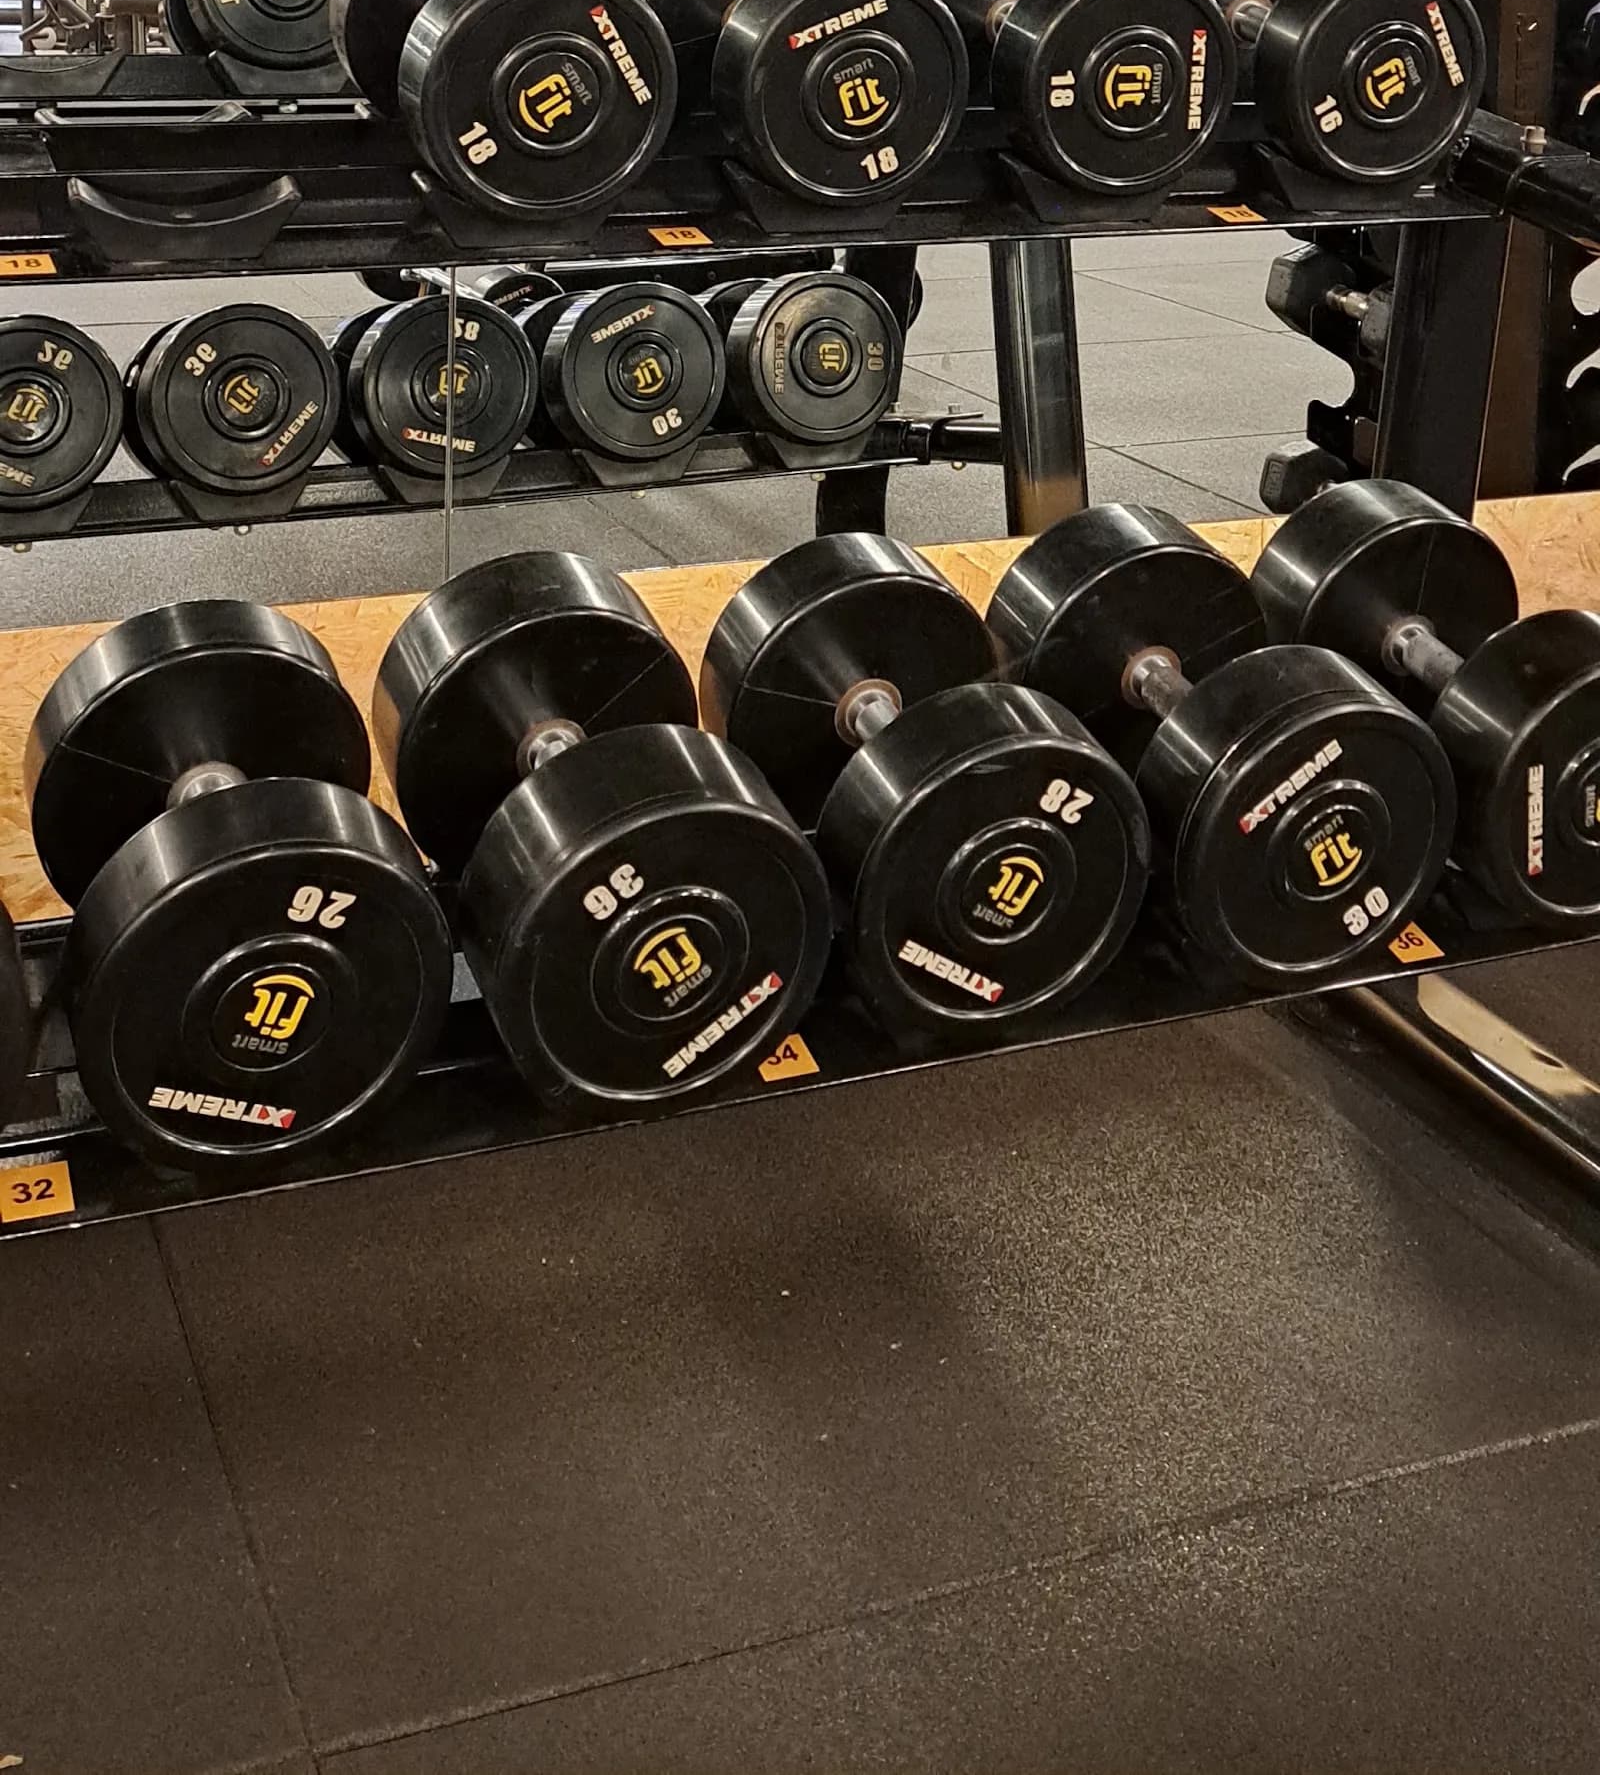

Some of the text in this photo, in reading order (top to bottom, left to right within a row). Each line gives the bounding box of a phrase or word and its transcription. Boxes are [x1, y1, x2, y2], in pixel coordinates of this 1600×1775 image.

[589, 4, 652, 106] XTREME
[1425, 1, 1465, 87] XTREME
[562, 62, 592, 106] smart
[833, 57, 874, 85] smart
[1050, 69, 1076, 108] 18
[1116, 63, 1153, 109] fit
[1151, 62, 1163, 105] smart
[1187, 28, 1208, 130] XTREME
[1372, 57, 1407, 106] fit
[1404, 53, 1421, 87] mart
[525, 73, 573, 129] fit
[838, 76, 886, 119] fit
[1313, 94, 1344, 134] 16
[458, 121, 498, 165] 18
[860, 145, 899, 181] 18
[665, 230, 697, 240] 18
[4, 257, 43, 269] 18
[1039, 778, 1095, 825] 28
[1238, 738, 1343, 835] XTREME
[1585, 784, 1597, 828] smart
[1303, 813, 1345, 852] smart
[1527, 764, 1545, 877] XTREME
[1309, 830, 1361, 884] fit
[287, 885, 357, 929] 26
[582, 863, 645, 921] 36
[987, 864, 1040, 917] fit
[1342, 886, 1390, 937] 30
[972, 902, 1015, 929] smart
[640, 932, 702, 991] fit
[898, 939, 1005, 1004] XTREME
[663, 963, 714, 1010] smart
[244, 986, 312, 1041] fit
[662, 971, 783, 1078] XTREME
[232, 1033, 289, 1056] smart
[148, 1086, 297, 1129] XTREME
[11, 1178, 56, 1205] 32
